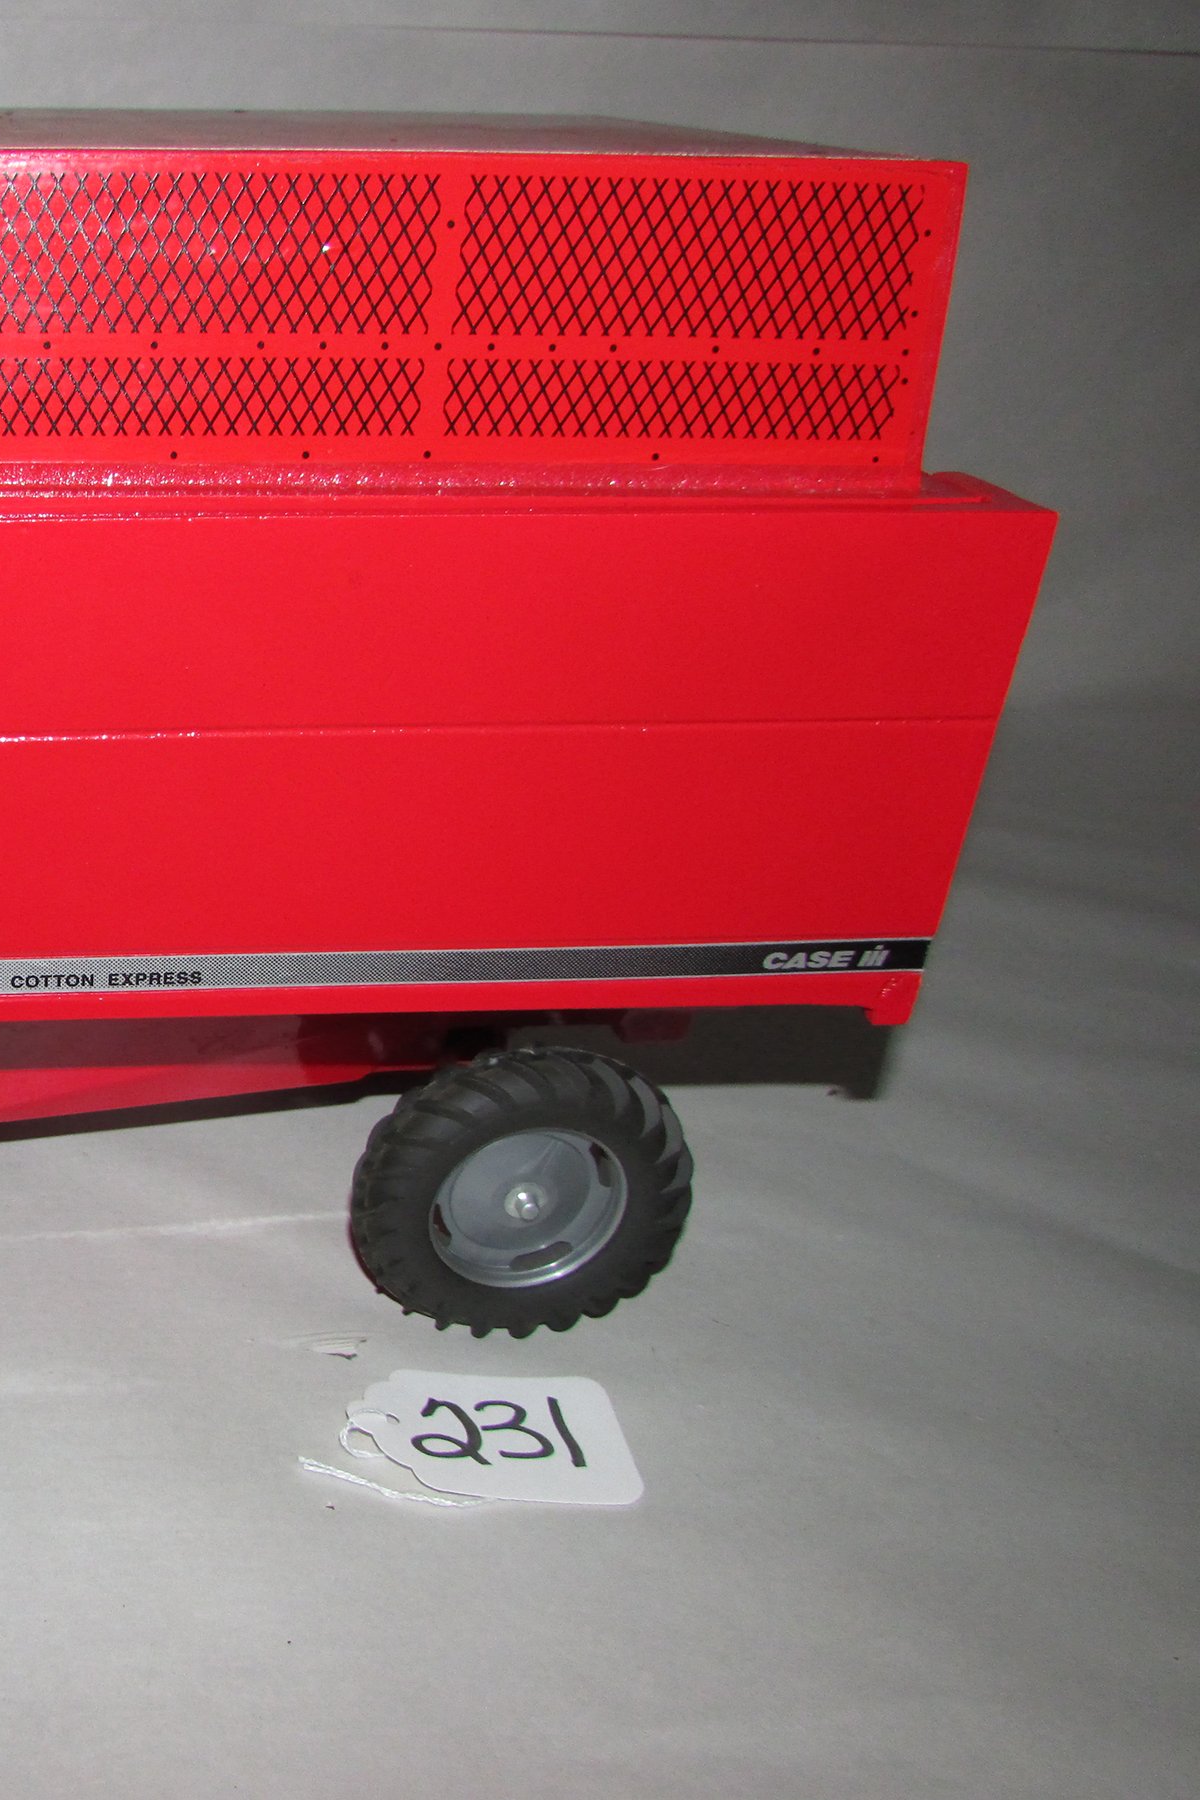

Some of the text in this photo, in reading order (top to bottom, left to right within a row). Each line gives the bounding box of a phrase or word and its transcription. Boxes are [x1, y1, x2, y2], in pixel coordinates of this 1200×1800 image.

[763, 951, 855, 970] CASE
[10, 973, 95, 989] COTTON
[108, 971, 202, 987] EXPRESS
[410, 1396, 587, 1467] 231
